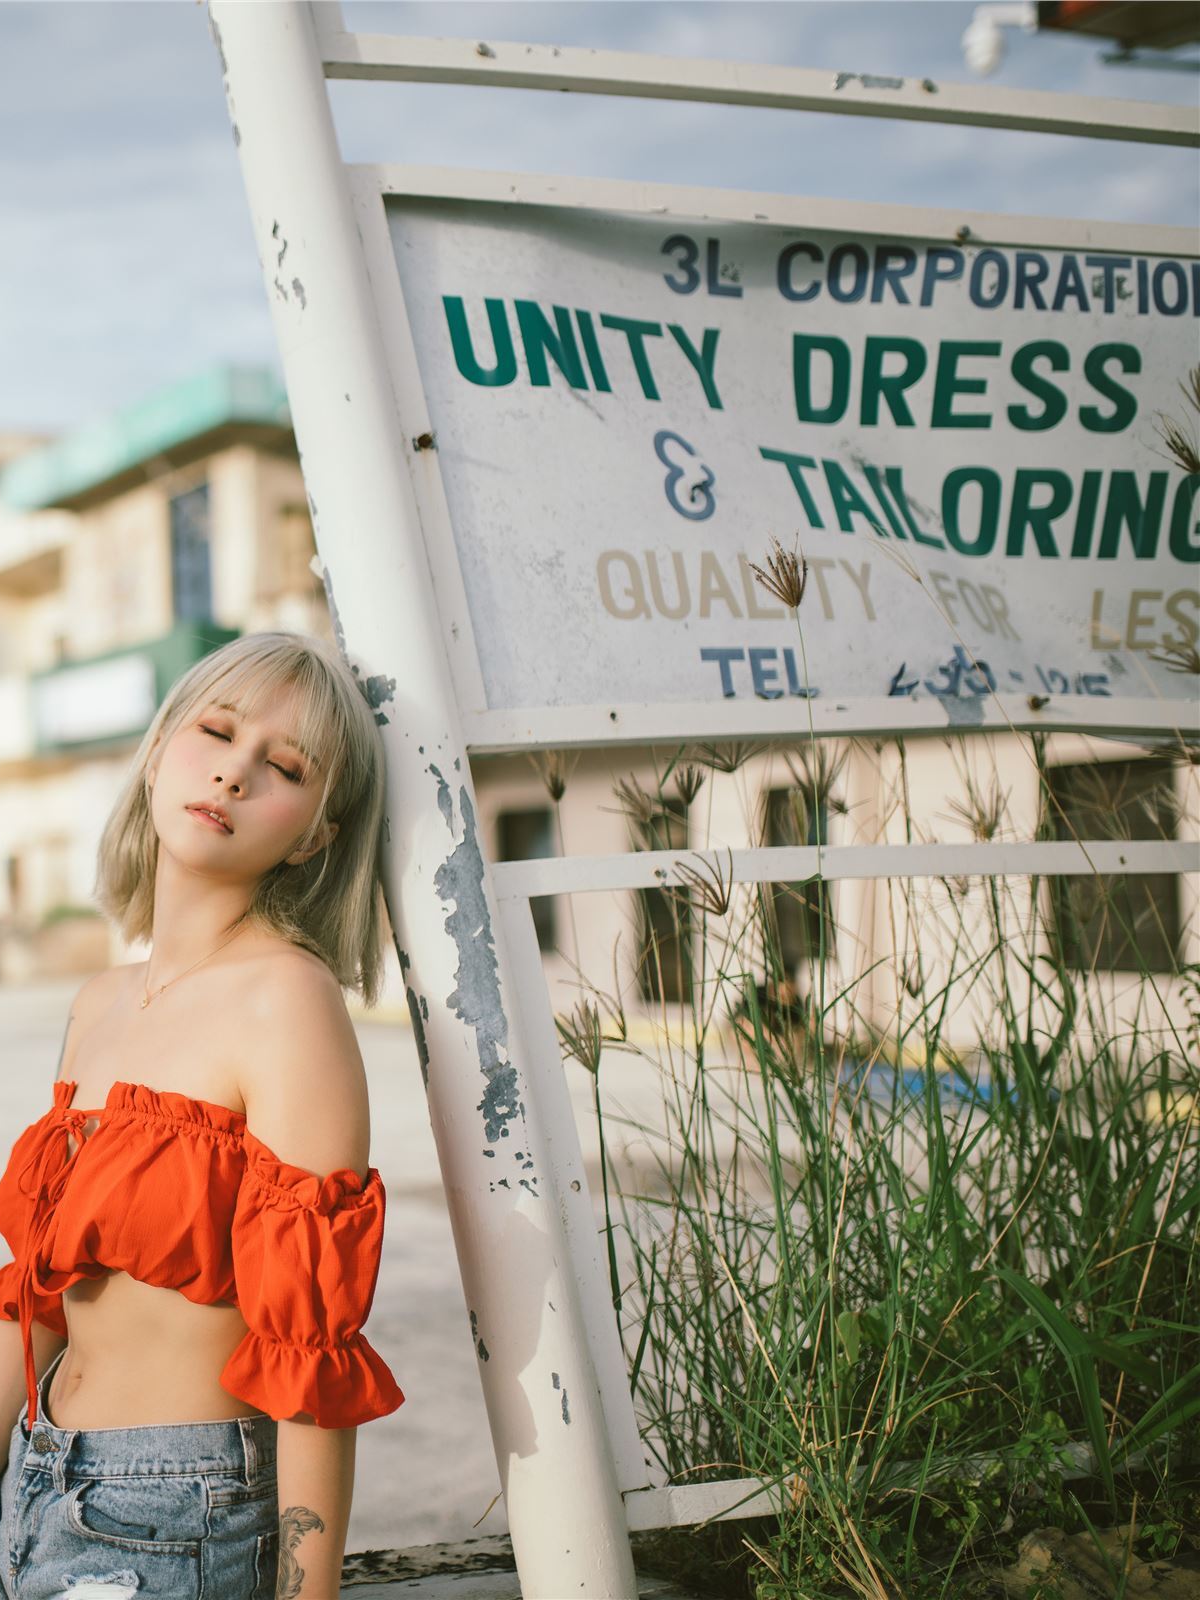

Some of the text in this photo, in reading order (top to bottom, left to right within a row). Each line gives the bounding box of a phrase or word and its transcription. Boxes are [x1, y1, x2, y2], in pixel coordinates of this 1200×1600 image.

[661, 234, 1200, 317] 3L CORPORATIO
[441, 295, 1142, 433] UNITY DRESS
[653, 430, 716, 521] &
[928, 570, 1021, 642] FOR
